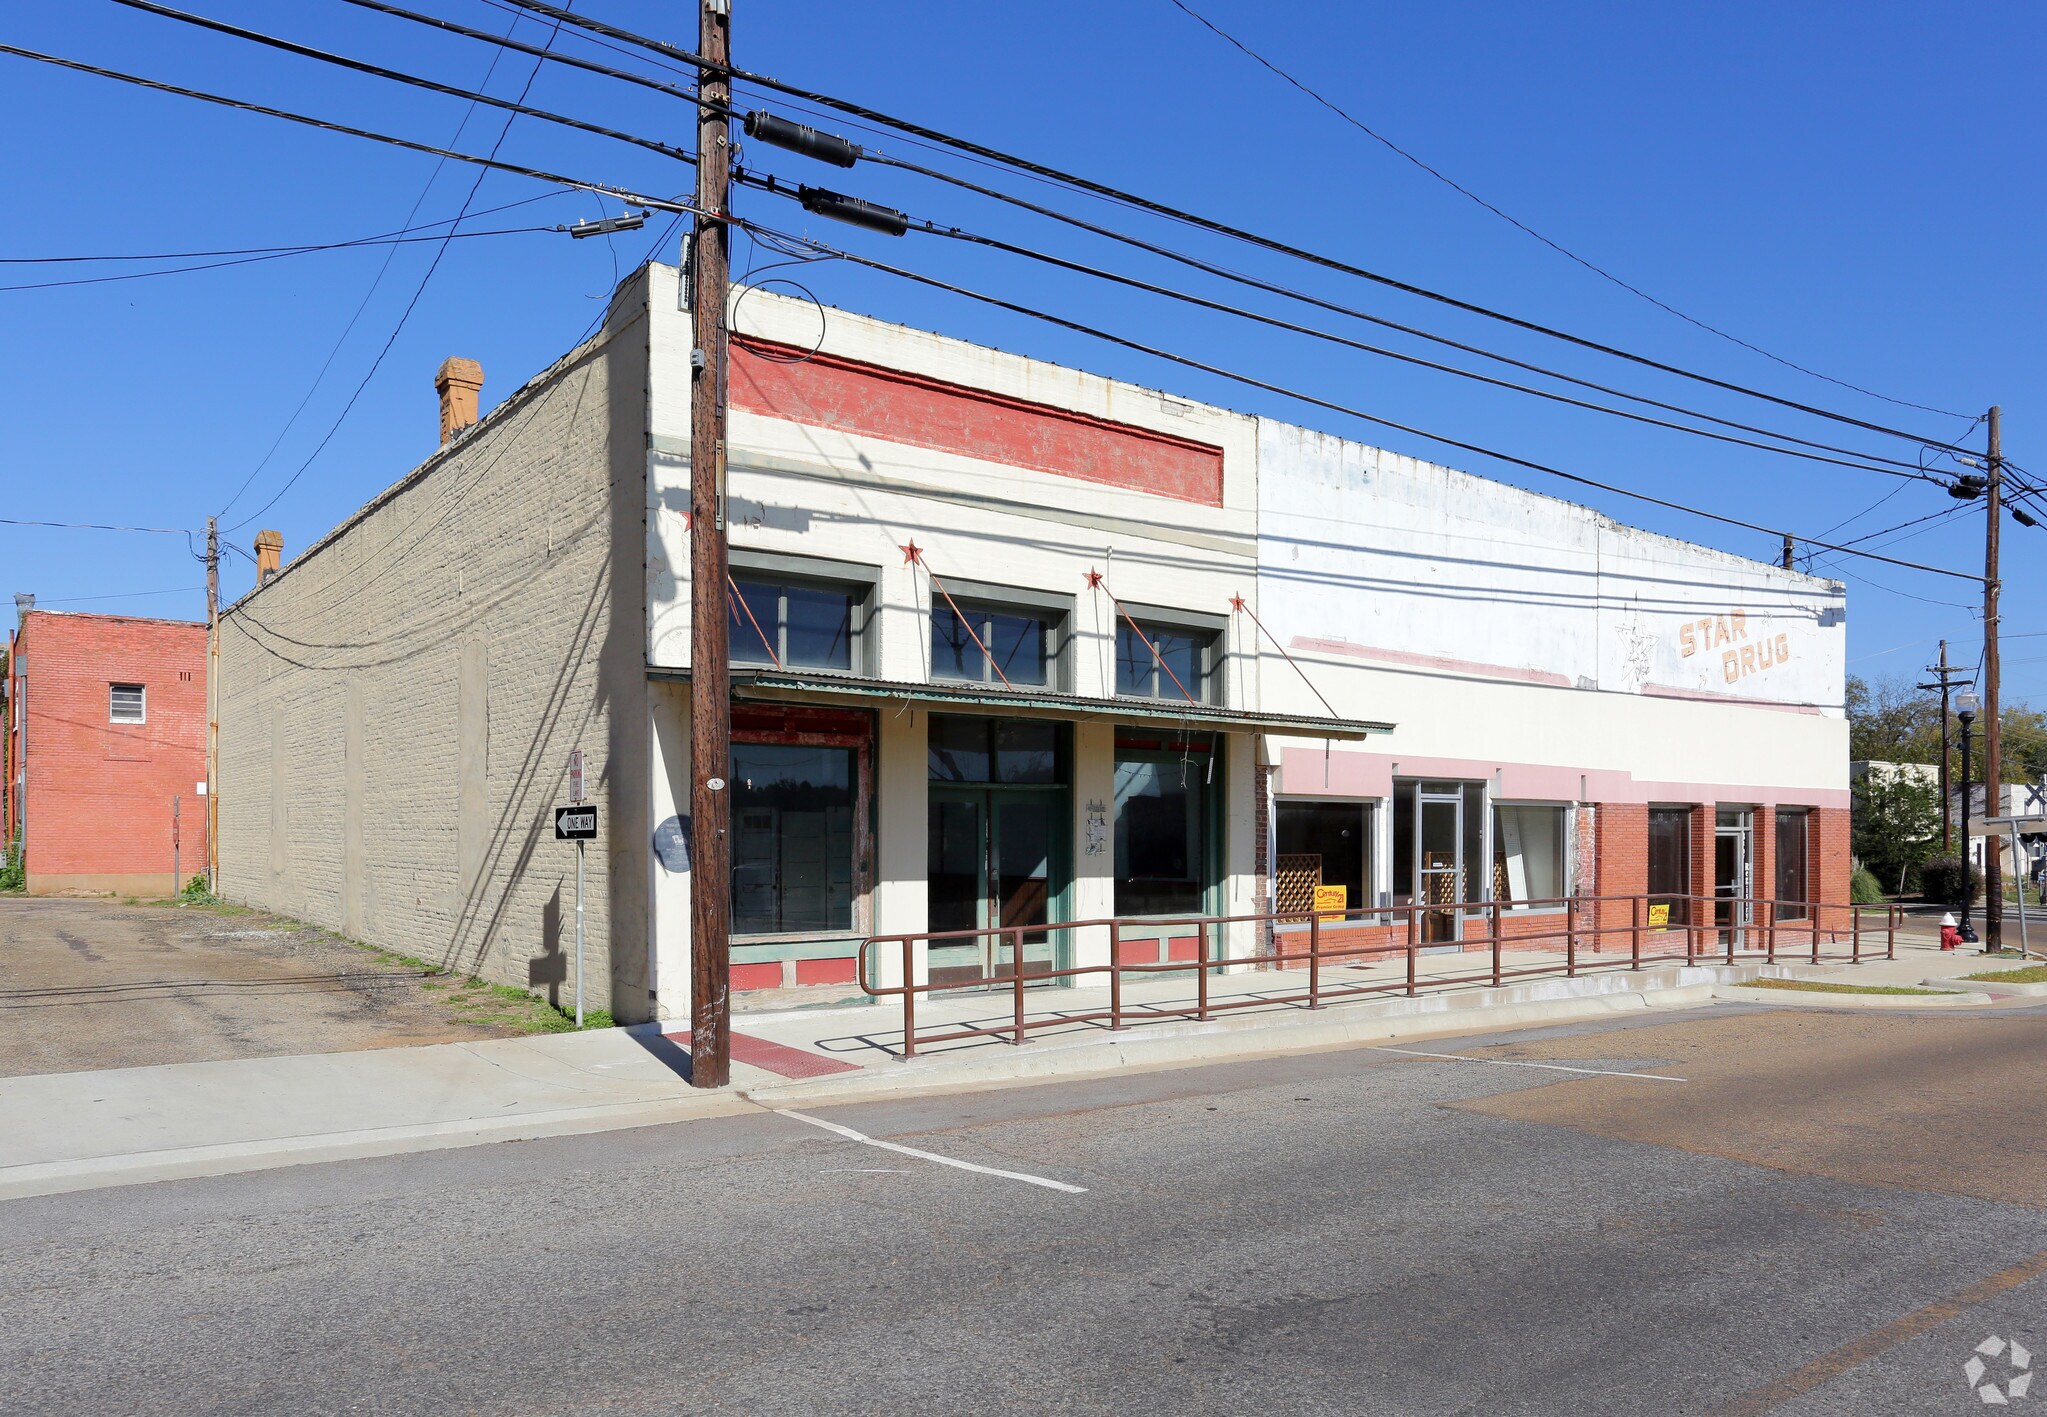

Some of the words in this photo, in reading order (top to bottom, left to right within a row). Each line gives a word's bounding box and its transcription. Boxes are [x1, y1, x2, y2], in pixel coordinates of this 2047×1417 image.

[1680, 609, 1747, 658] STAR
[1722, 633, 1789, 684] DRUG
[567, 817, 579, 829] ONE
[580, 816, 593, 829] WAY
[1338, 894, 1344, 903] 21
